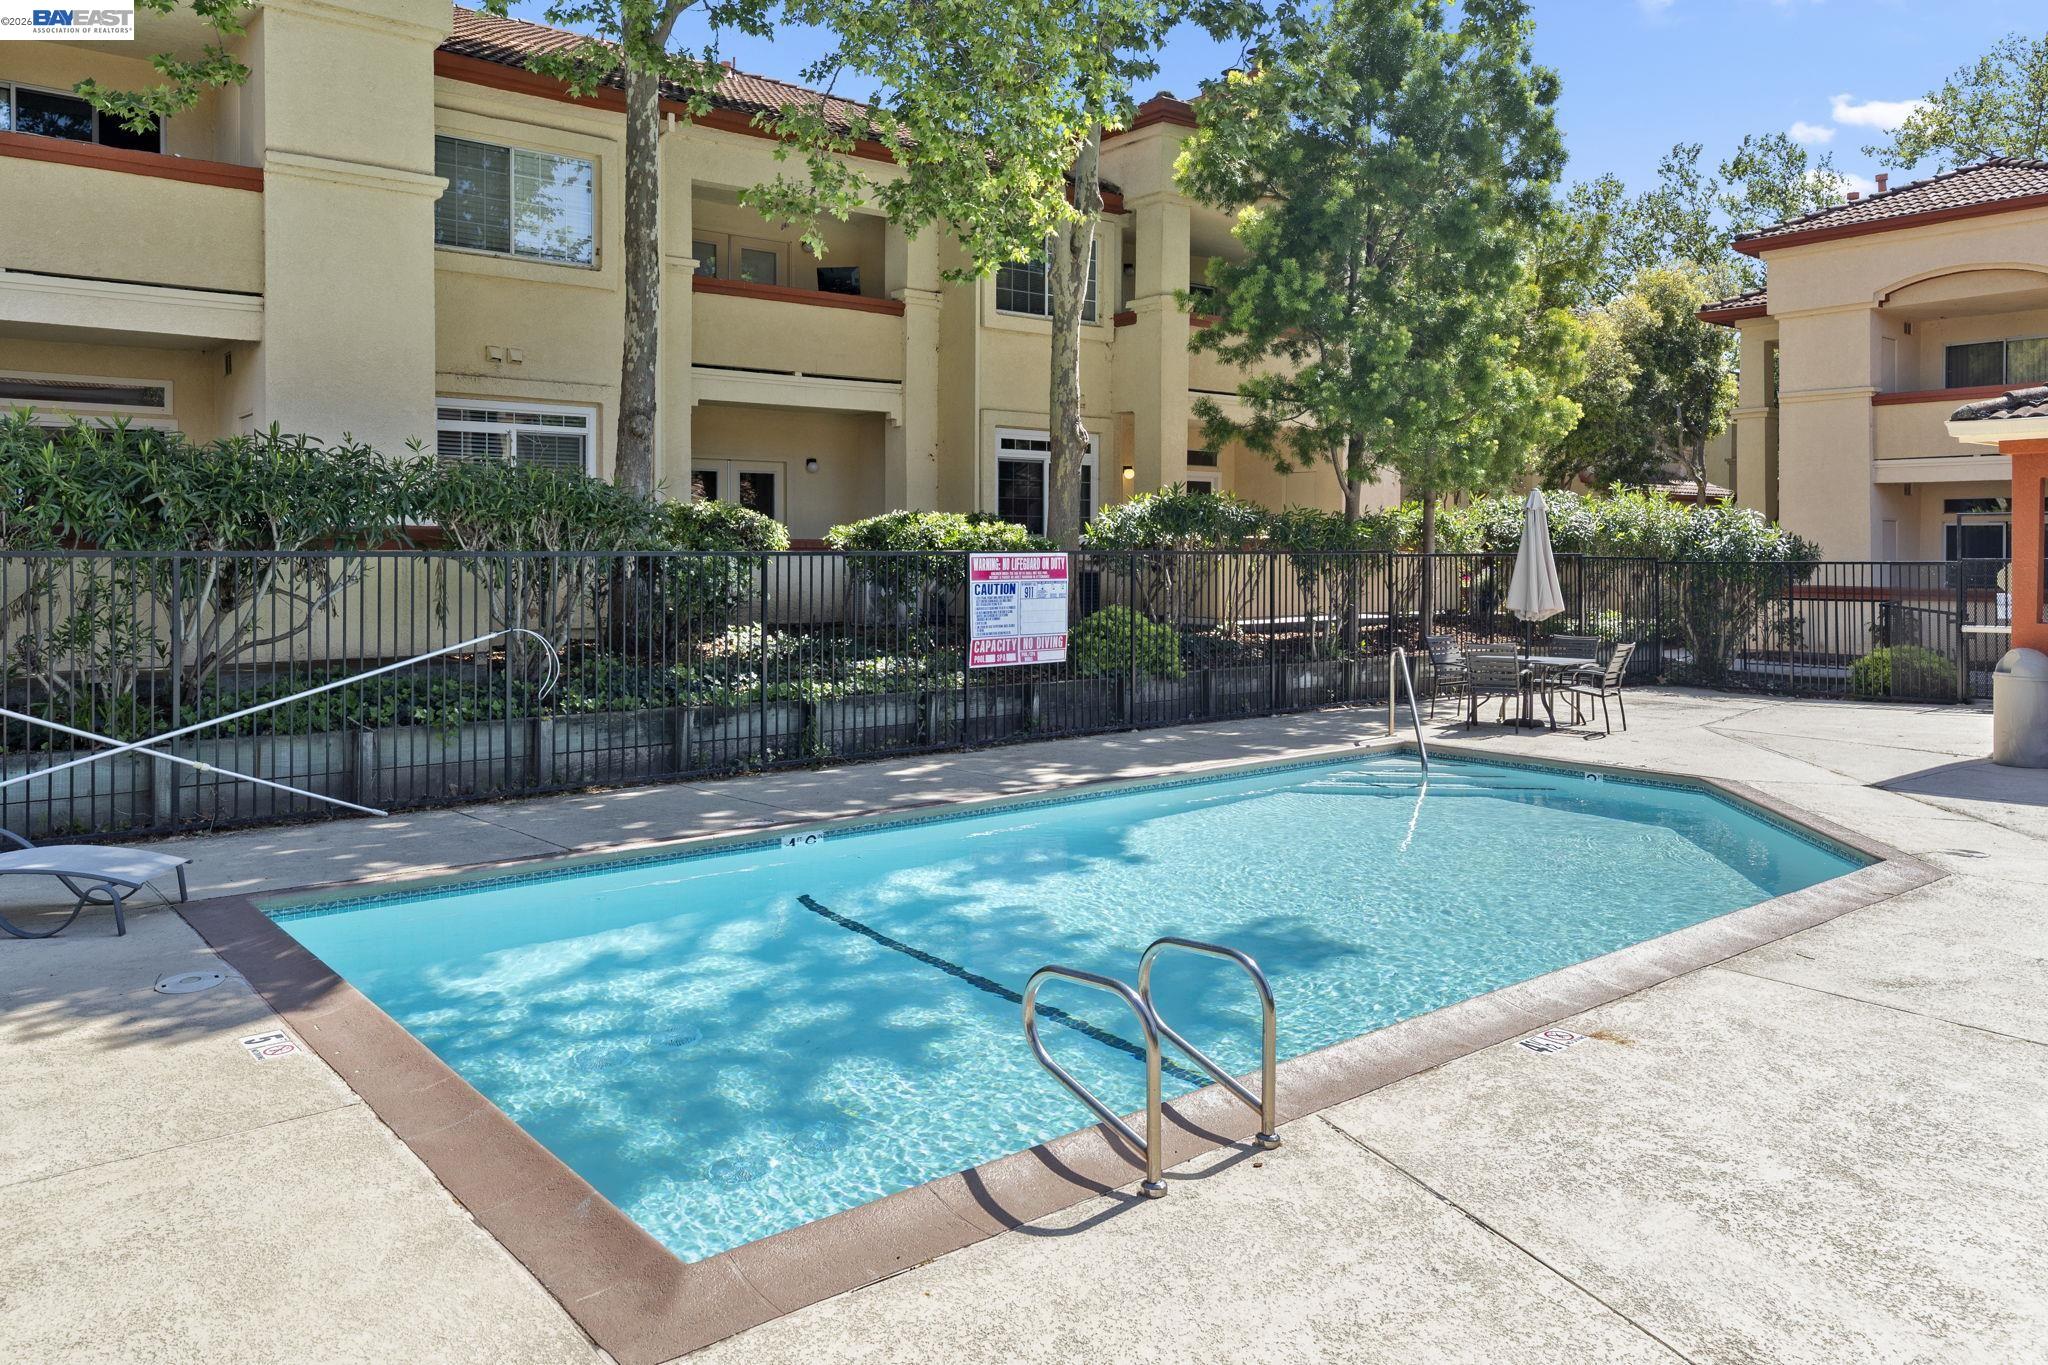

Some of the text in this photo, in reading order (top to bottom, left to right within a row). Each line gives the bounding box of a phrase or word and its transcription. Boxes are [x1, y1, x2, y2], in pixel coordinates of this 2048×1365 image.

[1002, 557, 1010, 571] NO
[1011, 557, 1041, 570] LIFEGUARD
[1042, 557, 1050, 570] ON
[1051, 557, 1065, 570] DUTY
[974, 583, 1016, 595] CAUTION
[1024, 587, 1034, 598] 911
[974, 638, 1017, 653] CAPACITY
[1023, 635, 1063, 650] NO DIVING
[997, 654, 1006, 662] SPA
[244, 1034, 284, 1044] 5
